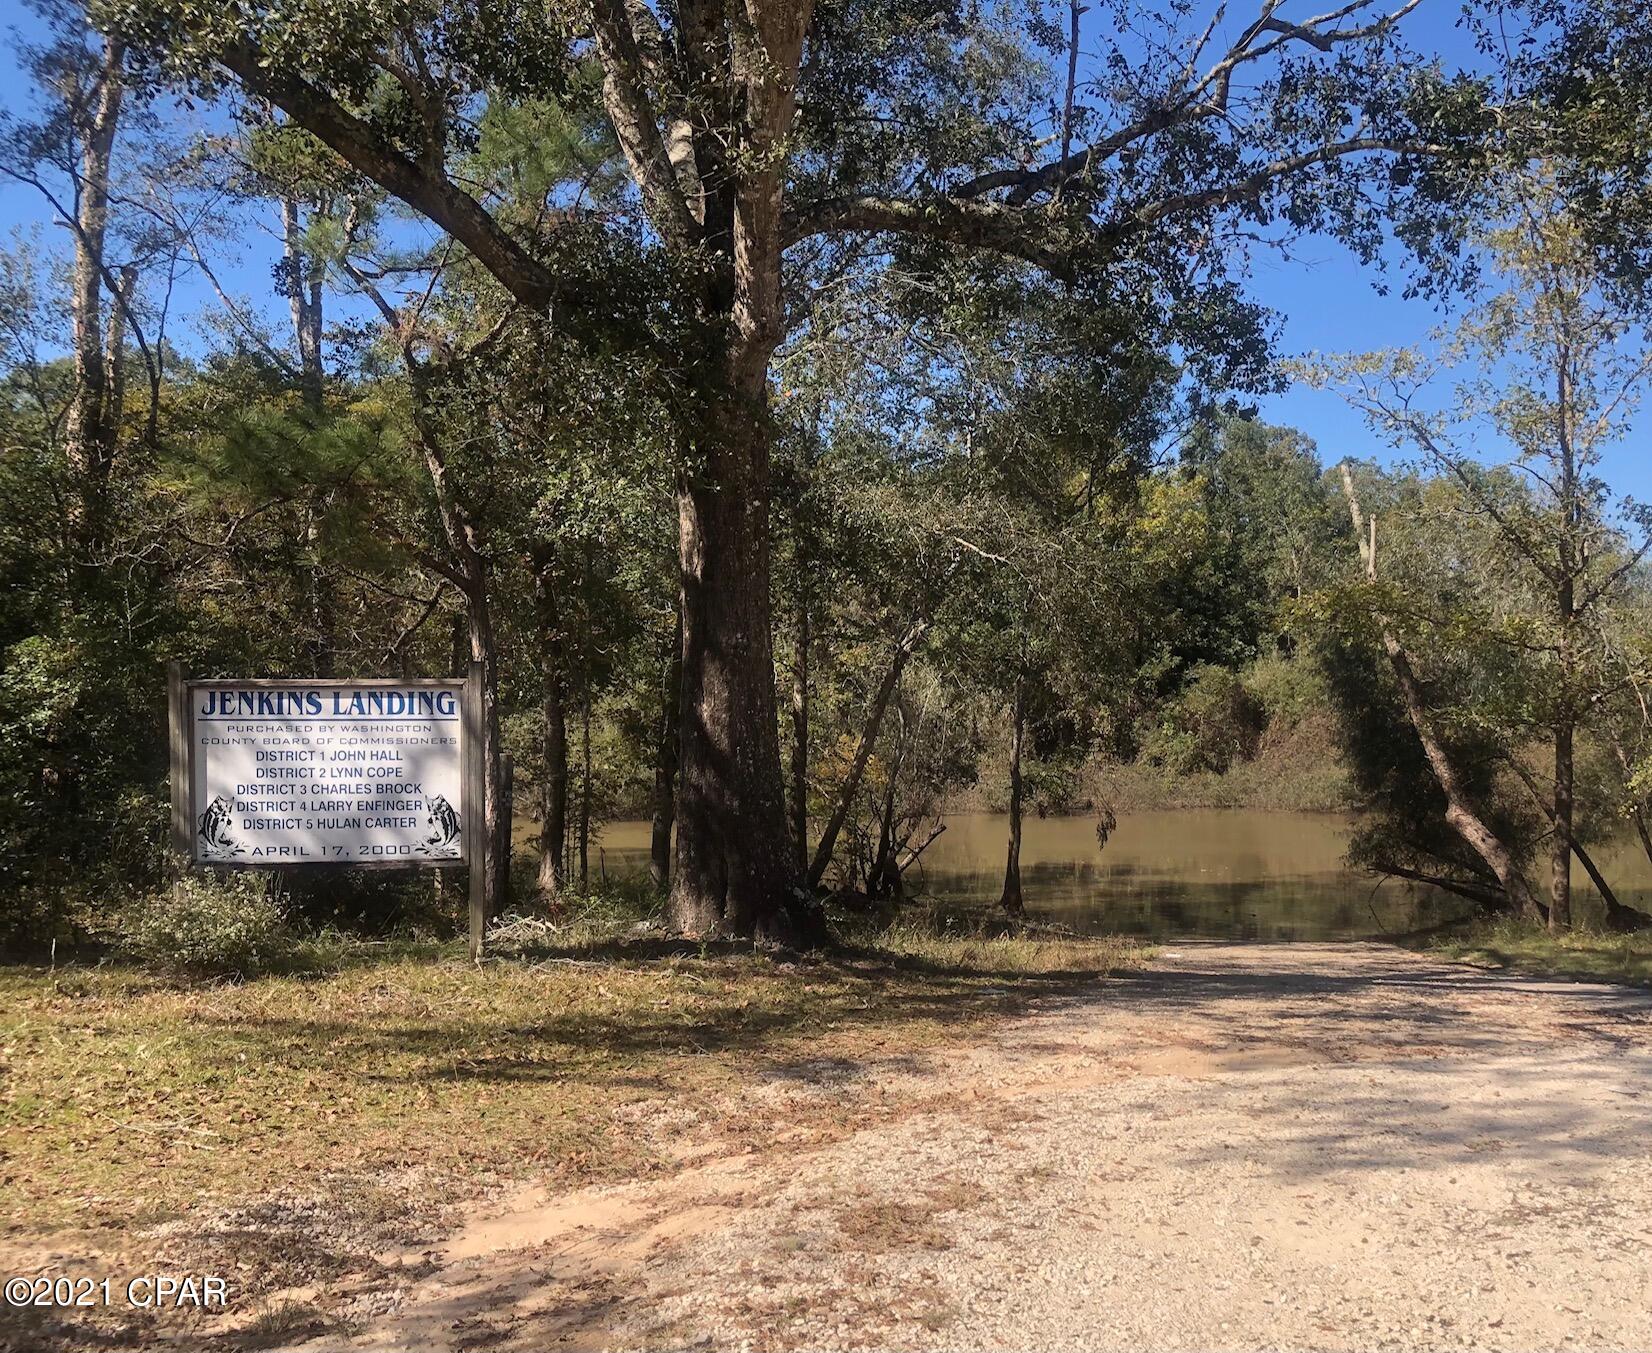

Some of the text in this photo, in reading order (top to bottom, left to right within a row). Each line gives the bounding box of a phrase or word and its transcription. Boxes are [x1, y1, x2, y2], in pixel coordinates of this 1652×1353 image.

[201, 691, 456, 716] JENKINS LANDING
[227, 725, 432, 733] PURCHASED BY WASHINGTON
[201, 737, 457, 745] COUNTY BOARD OF COMMISSIONERS
[256, 750, 403, 762] DISTRICT 1 JOHN HALL
[256, 767, 403, 779] DISTRICT 2 LYNN COPE
[237, 783, 422, 795] DISTRICT 3 CHARLES BROCK
[237, 800, 422, 812] DISTRICT 4 LARRY ENFINGER
[243, 817, 417, 829] DISTRICT 5 HULAN CARTER
[251, 845, 411, 857] APRIL 17, 2000
